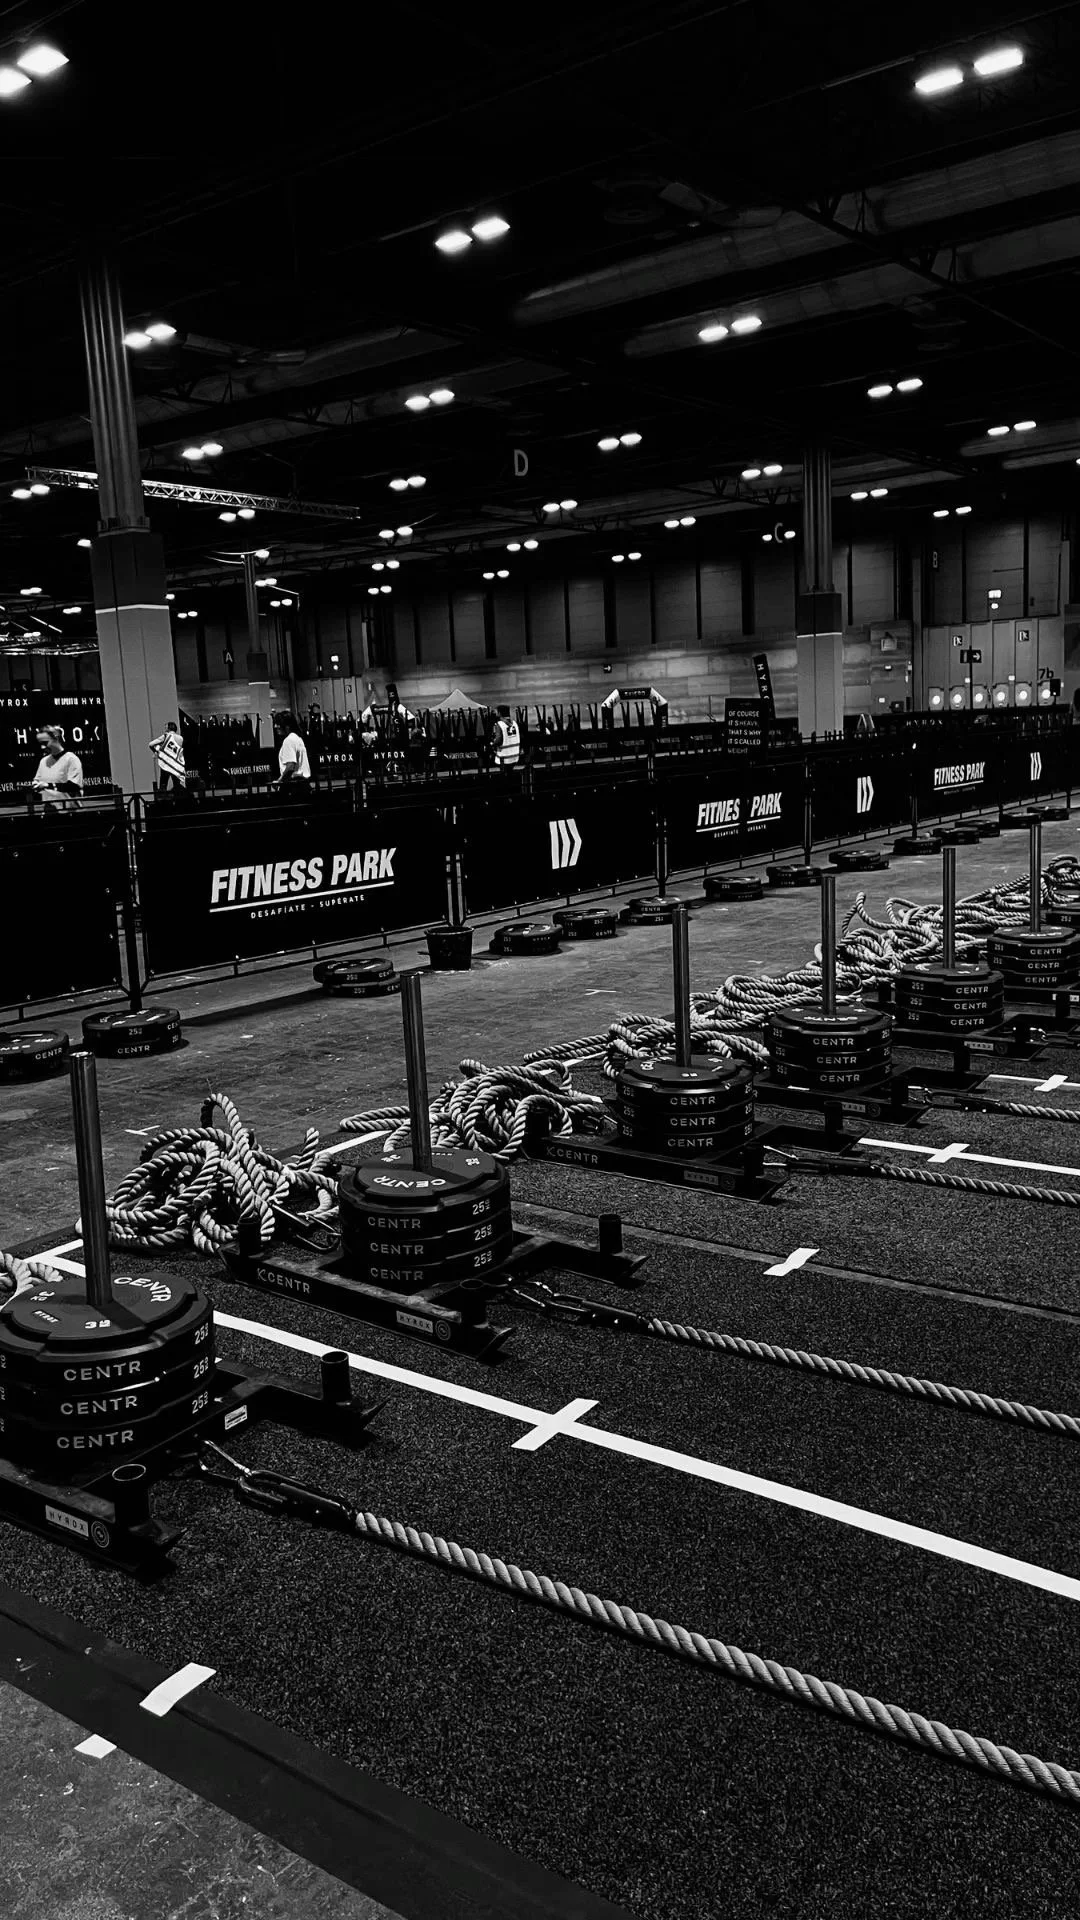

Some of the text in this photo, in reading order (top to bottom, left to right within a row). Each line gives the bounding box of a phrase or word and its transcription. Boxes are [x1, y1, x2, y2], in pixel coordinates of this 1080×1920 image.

[514, 449, 528, 476] D
[1039, 667, 1053, 679] 7b
[319, 754, 353, 763] HYROX
[374, 751, 405, 759] HYROX
[934, 761, 985, 786] FITNESS PARK
[697, 792, 782, 826] FITNES PARK
[211, 847, 396, 903] FITNESS PARK
[955, 986, 989, 994] CENTR
[954, 1002, 987, 1010] CENTR
[950, 1018, 984, 1026] CENTR
[812, 1037, 856, 1046] CENTR
[118, 1044, 150, 1054] CENTR
[816, 1056, 857, 1064] CENTR
[820, 1073, 860, 1082] CENTR
[669, 1095, 716, 1105] CENTR
[669, 1116, 716, 1126] CENTR
[667, 1137, 714, 1147] CENTR
[373, 1176, 446, 1188] CENTR
[367, 1216, 421, 1229] CENTR
[370, 1242, 424, 1255] CENTR
[370, 1268, 424, 1280] CENTR
[113, 1277, 172, 1302] CENTR
[64, 1360, 141, 1381] CENTR
[60, 1395, 138, 1415] CENTR
[56, 1430, 134, 1449] CENTR
